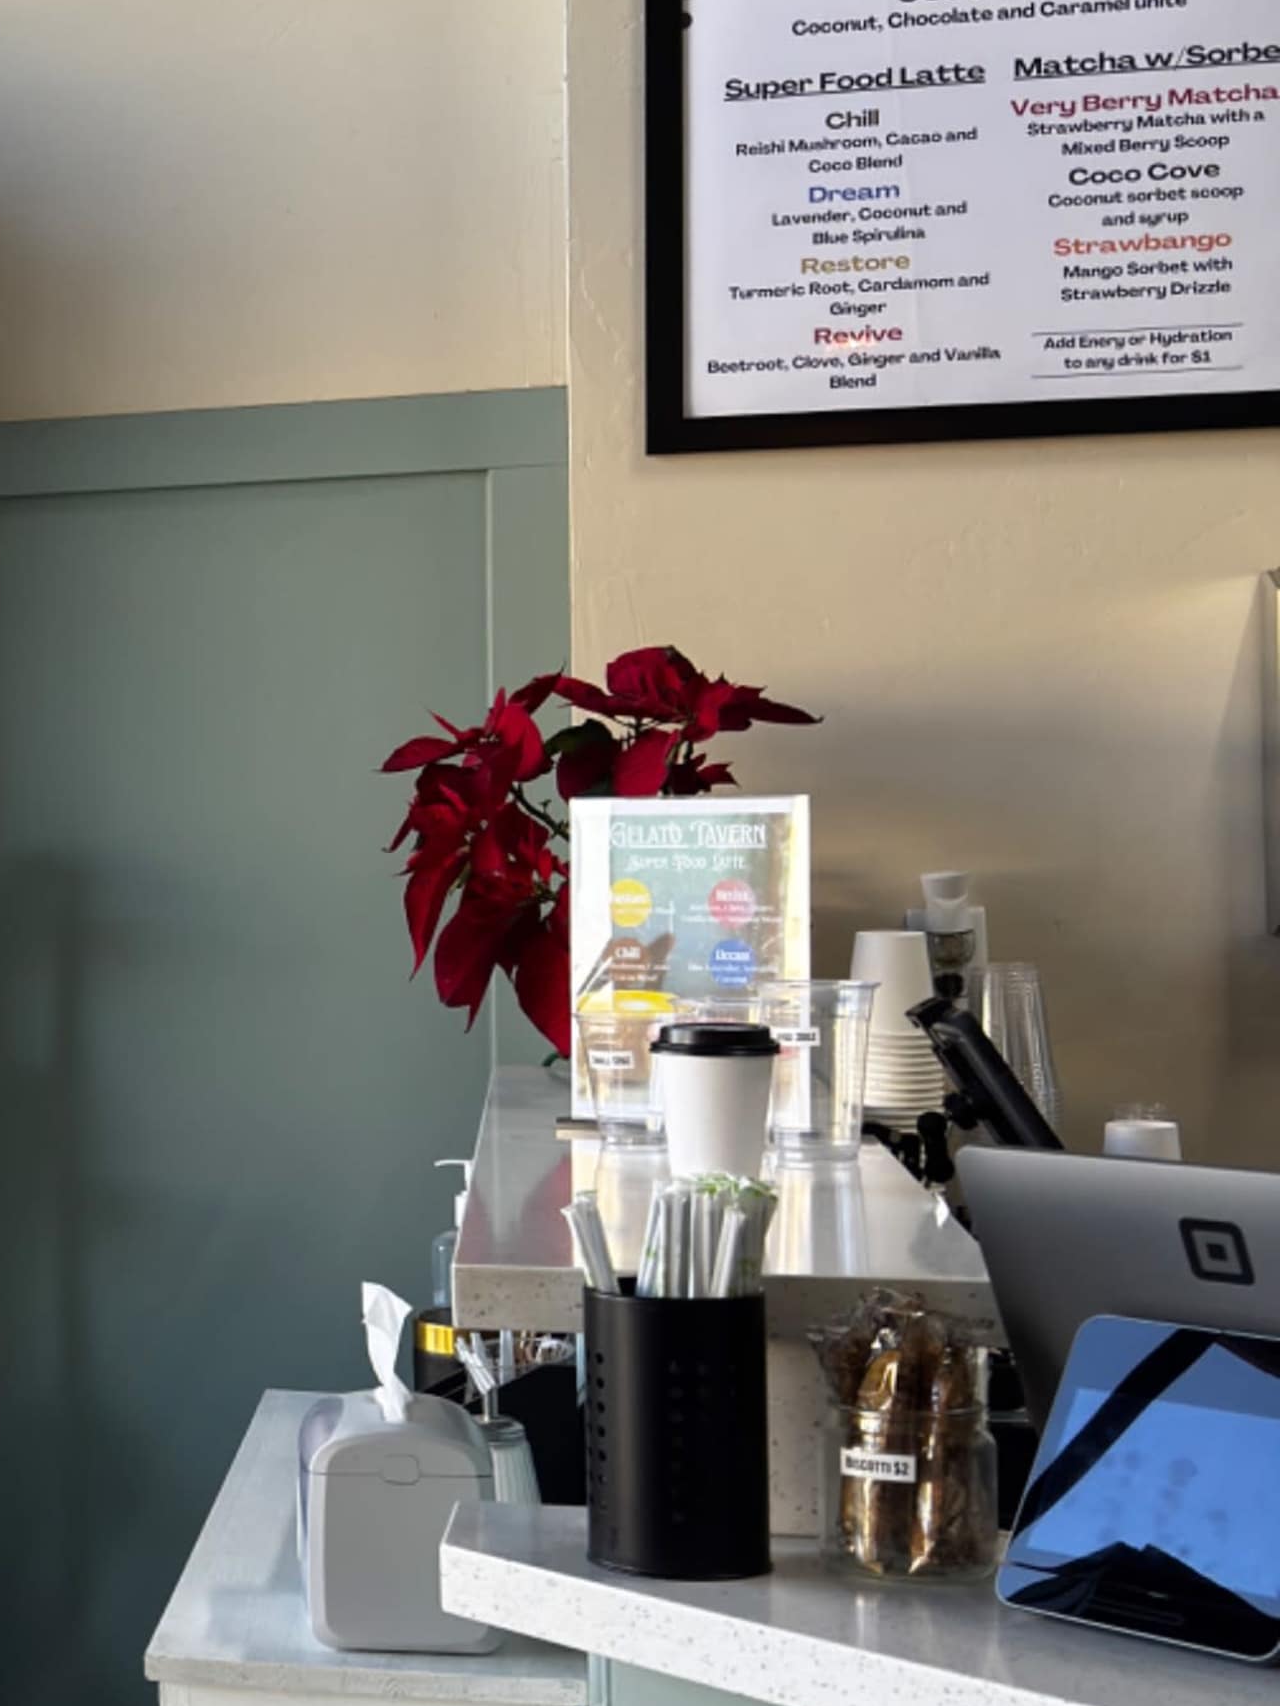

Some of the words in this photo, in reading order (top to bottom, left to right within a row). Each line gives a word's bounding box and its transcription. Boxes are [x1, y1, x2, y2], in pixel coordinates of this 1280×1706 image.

[792, 15, 883, 37] Coconut,
[888, 7, 993, 29] Chocolate
[997, 3, 1035, 21] and
[1014, 52, 1136, 78] Matcha
[725, 77, 813, 100] Super
[820, 68, 892, 90] Food
[900, 64, 986, 85] Latte
[1011, 98, 1077, 118] Very
[1082, 92, 1162, 112] Berry
[1168, 84, 1280, 106] Matcha
[825, 109, 880, 130] Chill
[1027, 117, 1133, 136] Strawberry
[1137, 111, 1206, 128] Matcha
[1210, 108, 1250, 123] with
[1253, 111, 1265, 122] a
[736, 140, 786, 156] Reishi
[790, 136, 882, 153] Mushroom,
[886, 131, 941, 146] Cacao
[945, 127, 978, 141] and
[1061, 139, 1115, 156] Mixed
[1119, 137, 1171, 153] Berry
[1174, 134, 1230, 149] Scoop
[808, 158, 853, 173] Coco
[856, 154, 903, 170] Blend
[1069, 167, 1143, 186] Coco
[1147, 163, 1220, 181] Cove
[808, 184, 900, 204] Dream
[1048, 189, 1123, 208] Coconut
[1127, 187, 1187, 203] sorbet
[1190, 186, 1244, 199] scoop
[772, 210, 856, 226] Lavender,
[858, 204, 932, 221] Coconut
[935, 201, 968, 215] and
[1101, 211, 1135, 227] and
[1139, 210, 1189, 226] syrup
[812, 230, 849, 245] Blue
[852, 226, 926, 243] Spirulina
[1053, 233, 1232, 257] Strawbango
[800, 255, 910, 274] Restore
[1063, 264, 1123, 280] Mango
[1127, 259, 1189, 275] Sorbet
[1192, 256, 1233, 271] with
[729, 284, 805, 300] Turmeric
[809, 281, 855, 296] Root,
[858, 275, 955, 293] Cardamom
[957, 272, 990, 286] and
[1061, 283, 1167, 302] Strawberry
[1170, 280, 1231, 296] Drizzle
[829, 301, 887, 318] Ginger
[813, 325, 903, 345] Revive
[1044, 336, 1075, 350] Add
[1129, 335, 1146, 346] or
[1150, 329, 1233, 348] Hydration
[707, 358, 789, 374] Beetroot,
[792, 355, 845, 370] Clove,
[848, 351, 905, 368] Ginger
[908, 349, 941, 363] and
[944, 346, 1001, 361] Vanilla
[1064, 357, 1082, 370] to
[1085, 358, 1114, 371] any
[1117, 353, 1158, 367] drink
[1162, 351, 1188, 365] for
[829, 374, 877, 390] Blend
[893, 1461, 910, 1476] $2
